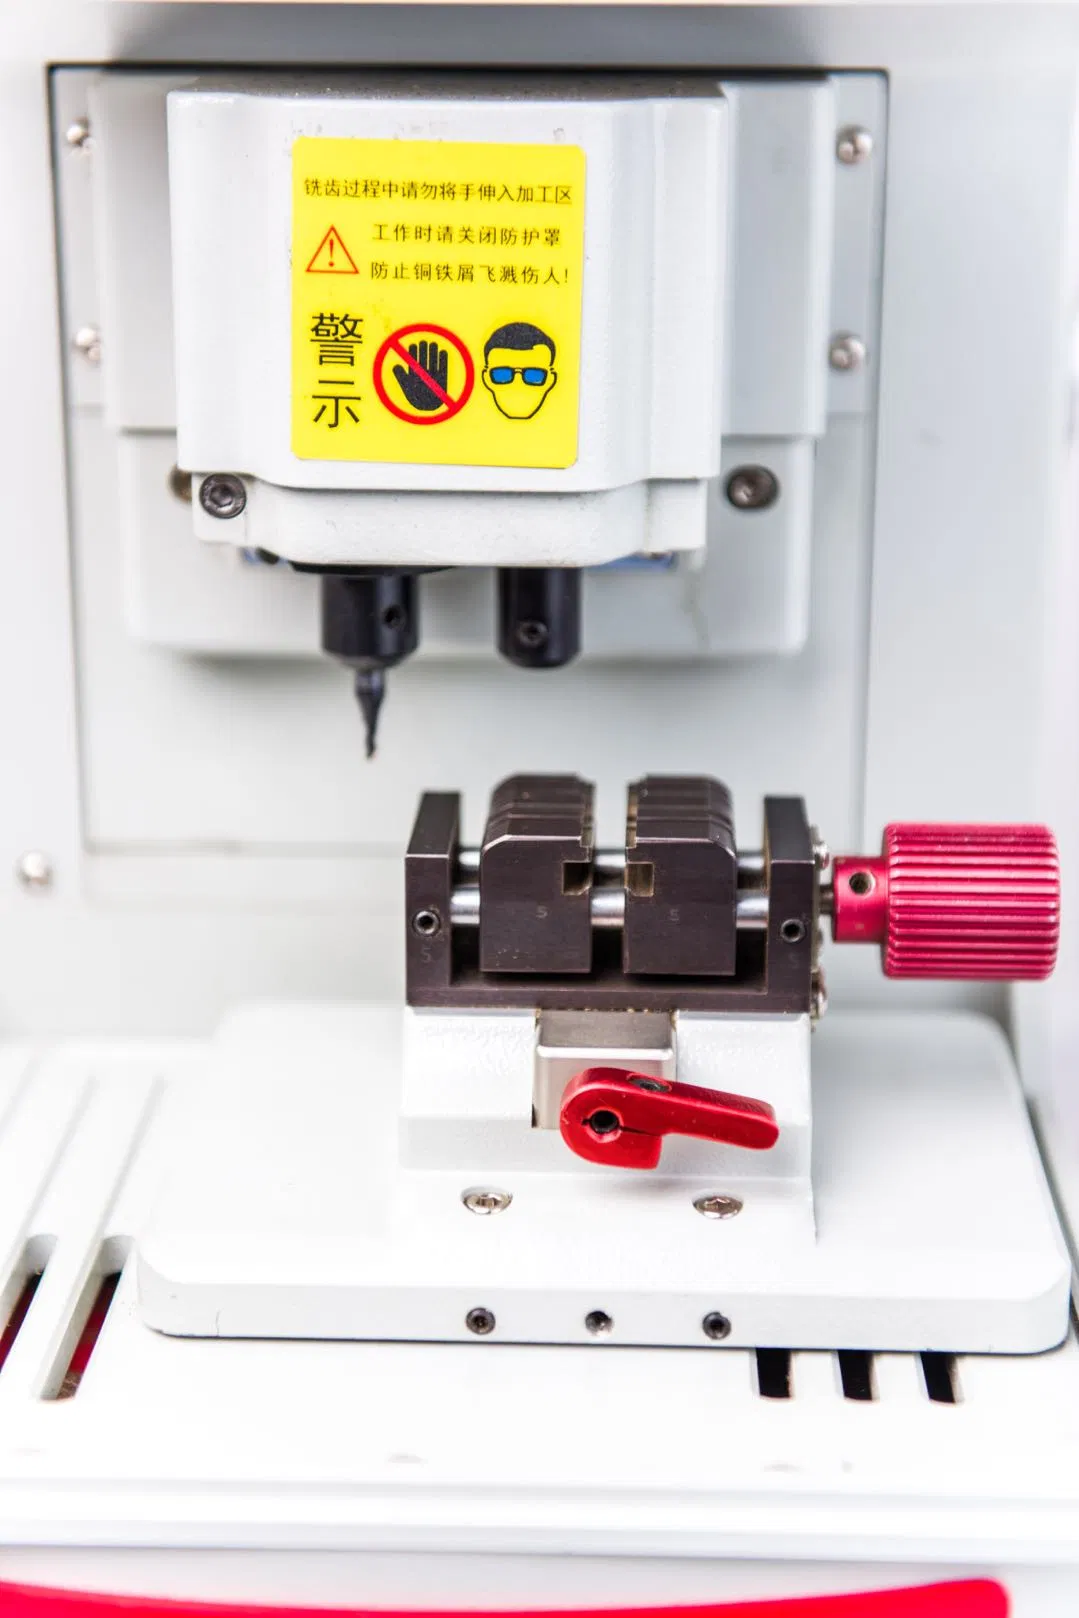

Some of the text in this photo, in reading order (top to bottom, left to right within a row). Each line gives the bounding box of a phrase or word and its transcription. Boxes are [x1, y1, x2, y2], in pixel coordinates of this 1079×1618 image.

[304, 177, 573, 204] 铣齿过程中请勿将手伸入加工区
[372, 223, 562, 247] 工作时请关闭防护罩
[310, 312, 364, 429] 警示
